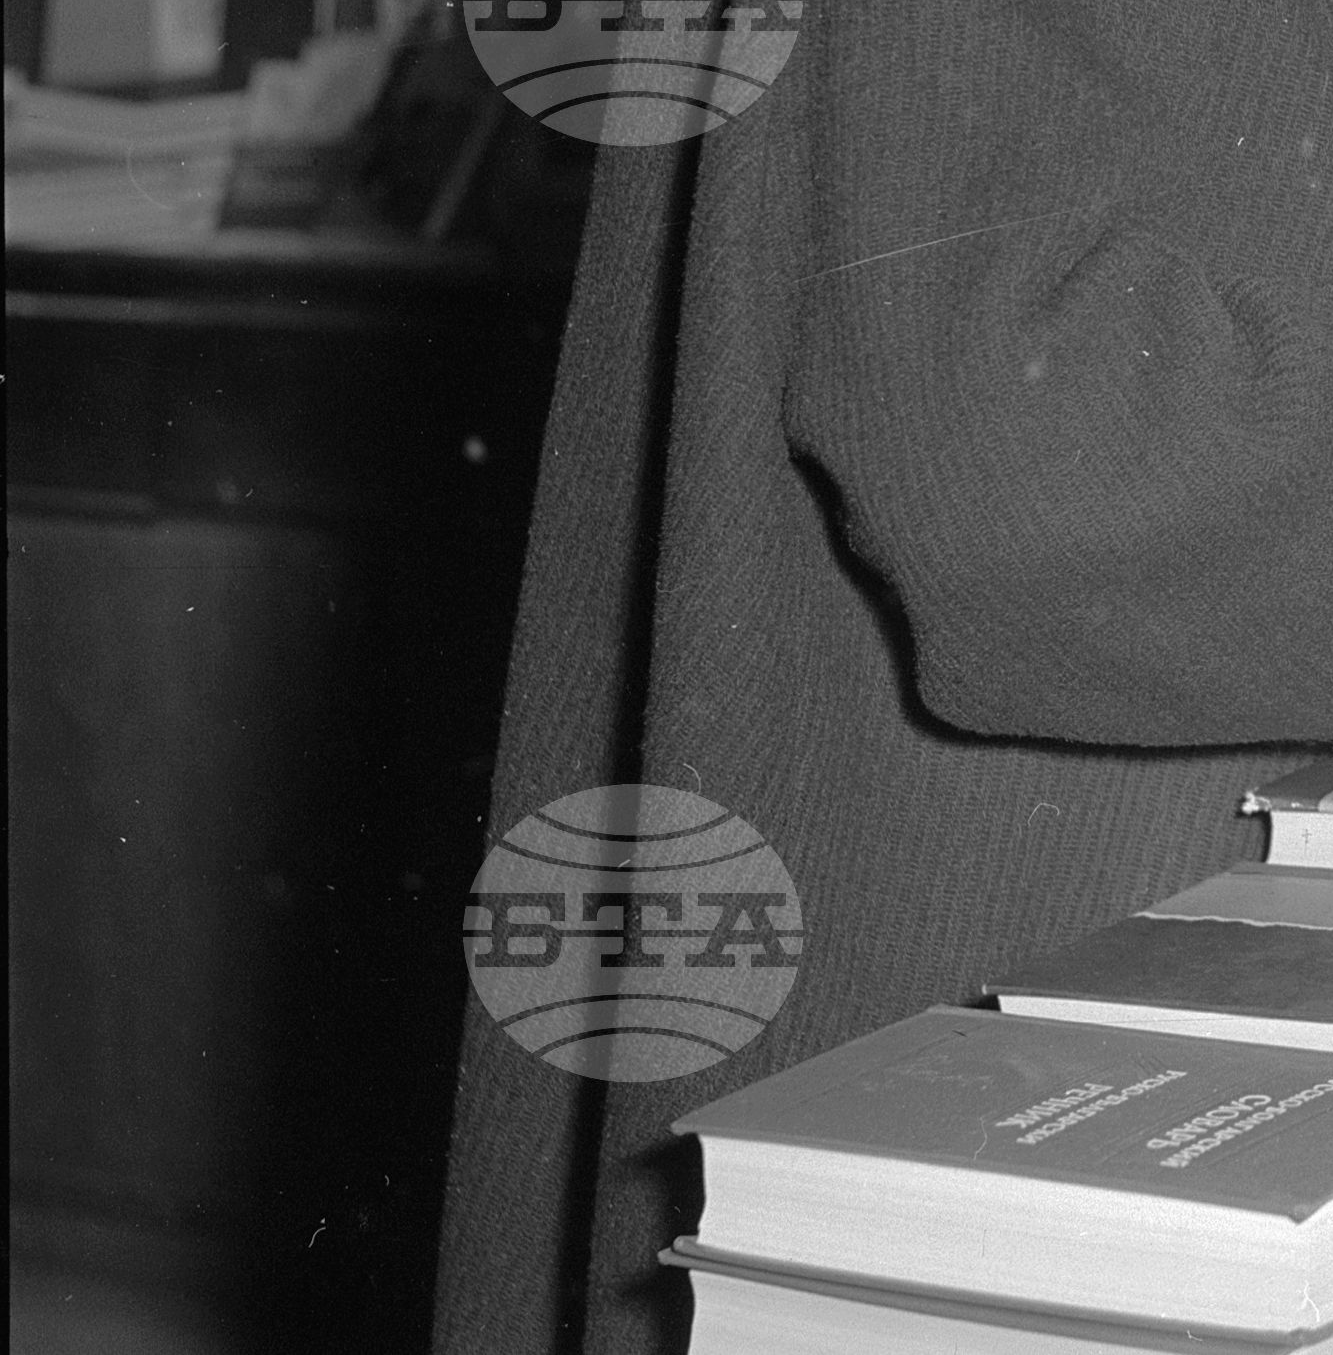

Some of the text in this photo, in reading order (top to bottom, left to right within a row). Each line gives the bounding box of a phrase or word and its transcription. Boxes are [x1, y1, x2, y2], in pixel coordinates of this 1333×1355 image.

[995, 1082, 1115, 1129] РЕЧНИК
[1016, 1069, 1188, 1144] РУСКО-БЪЛГАРСКИ
[1147, 1094, 1272, 1149] СЛОВАРЬ
